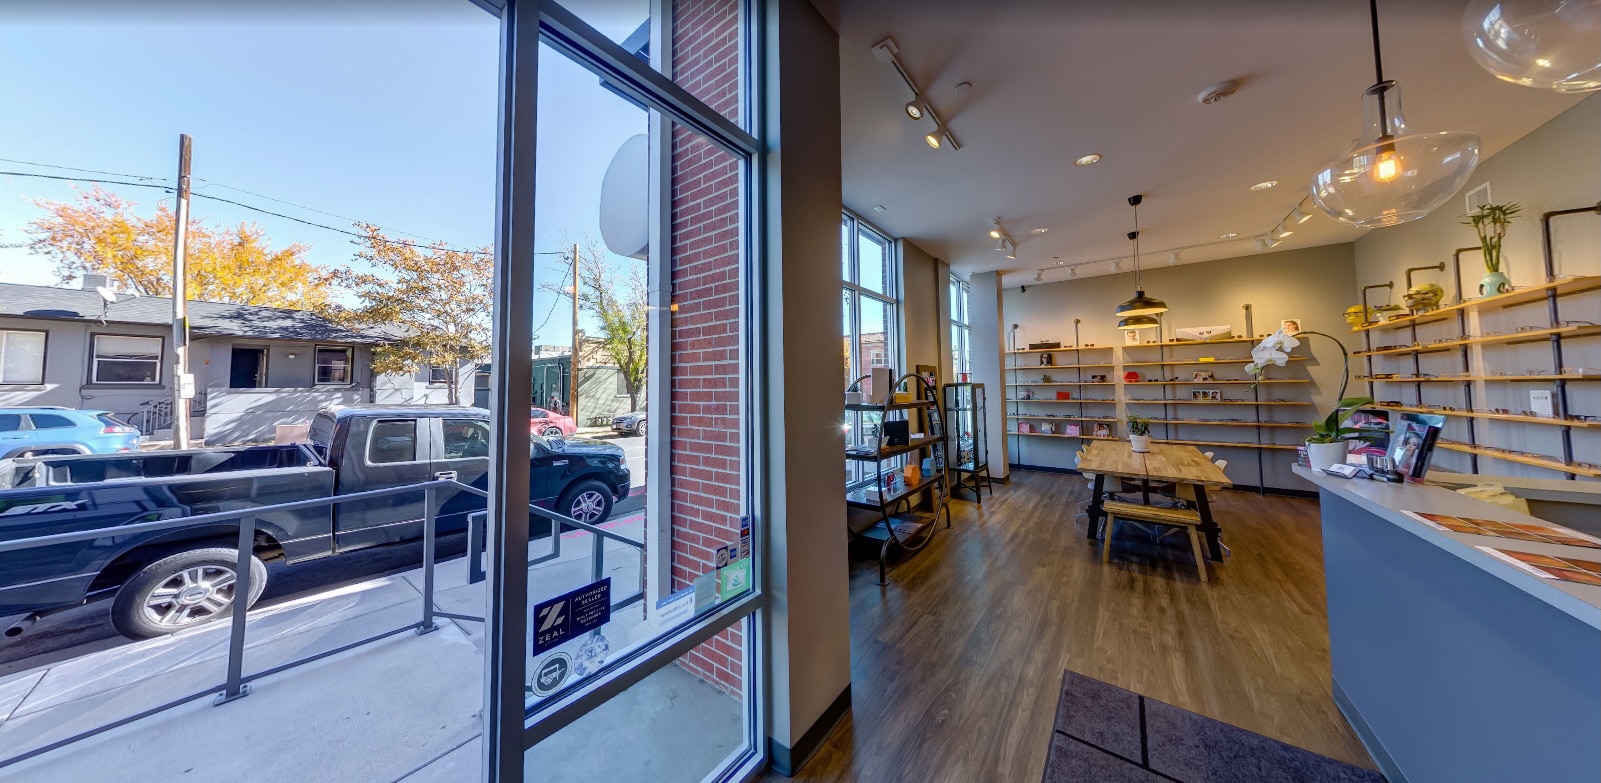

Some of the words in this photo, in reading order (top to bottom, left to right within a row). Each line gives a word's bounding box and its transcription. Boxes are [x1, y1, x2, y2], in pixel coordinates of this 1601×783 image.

[574, 585, 608, 602] AUTHORIZED
[581, 594, 602, 605] DEALER
[538, 628, 565, 645] ZEAL
